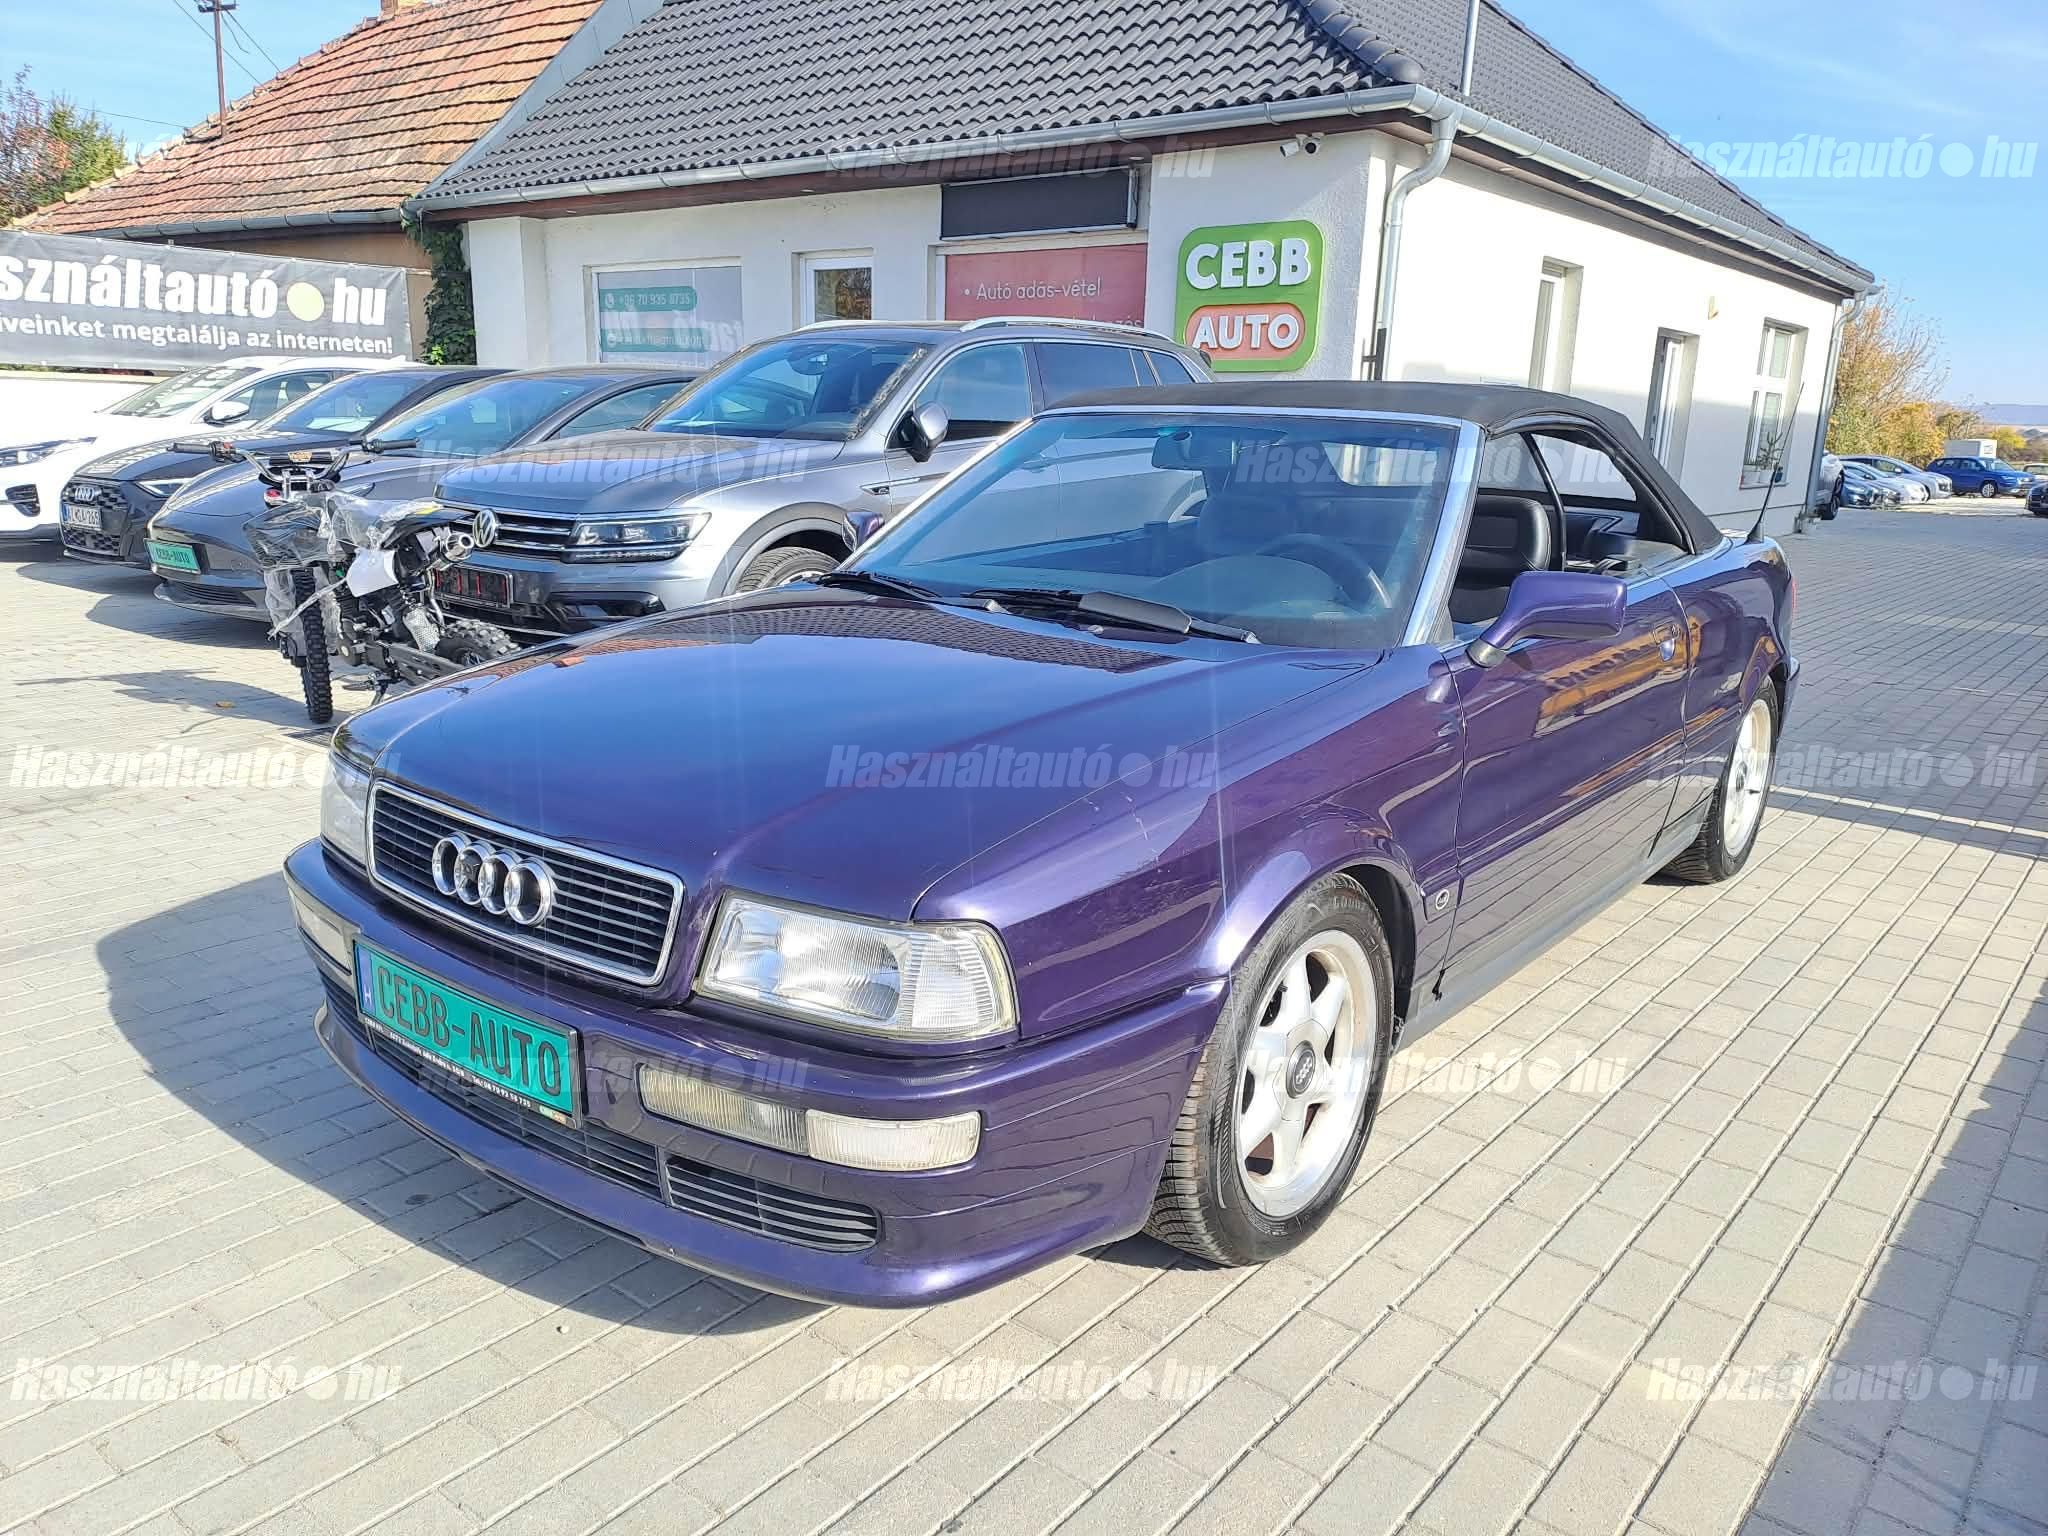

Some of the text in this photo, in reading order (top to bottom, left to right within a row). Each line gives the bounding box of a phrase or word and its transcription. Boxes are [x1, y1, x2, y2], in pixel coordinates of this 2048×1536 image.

[1186, 238, 1311, 289] CEBB
[112, 322, 240, 350] megtalálja
[247, 332, 272, 347] az
[277, 330, 393, 354] interneten!
[1192, 314, 1299, 349] AUTO
[377, 966, 562, 1097] CEBB-AUTO
